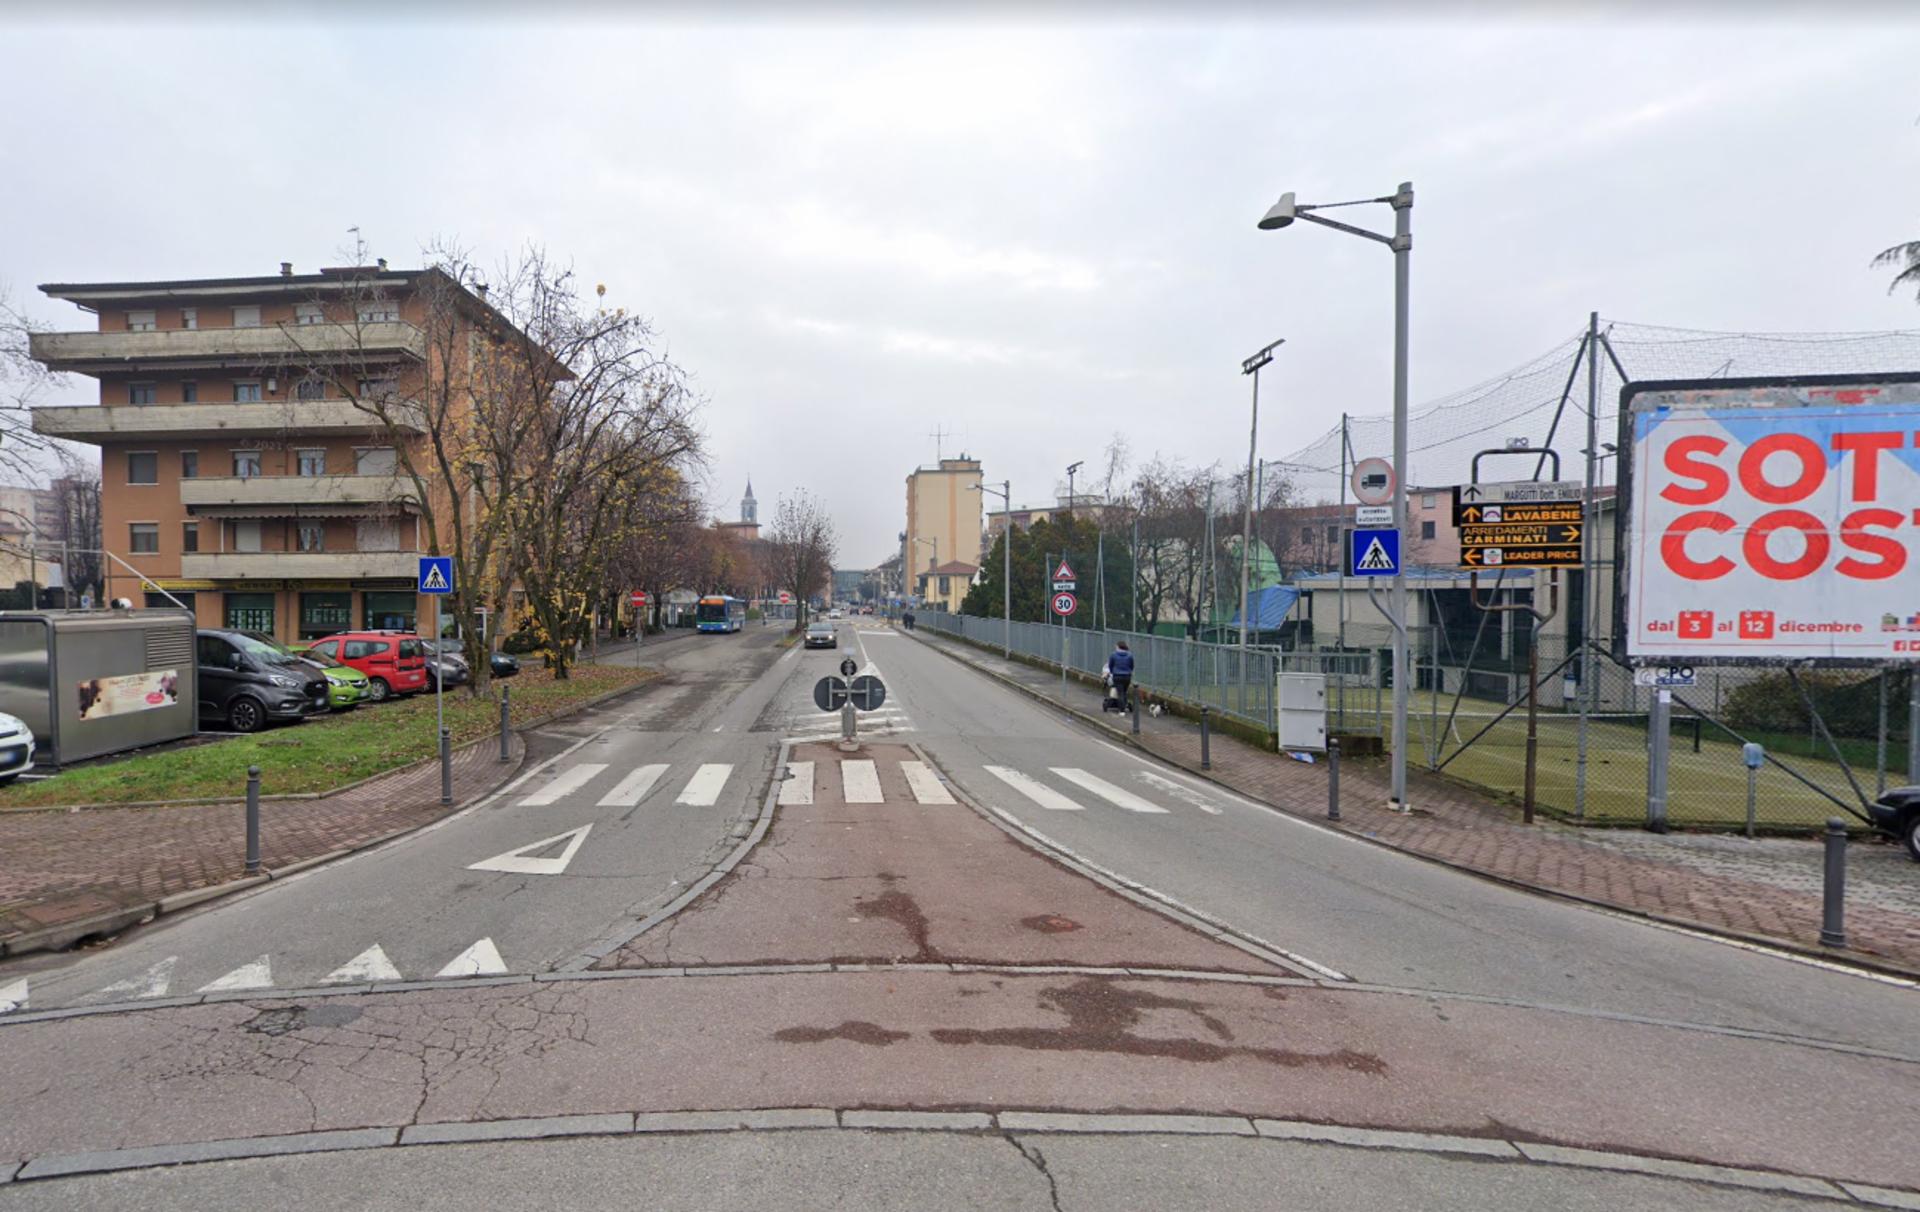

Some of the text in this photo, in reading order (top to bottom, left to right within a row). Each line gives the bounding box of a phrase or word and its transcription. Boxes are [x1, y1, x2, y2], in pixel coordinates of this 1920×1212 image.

[1659, 431, 1920, 505] SOT
[1503, 510, 1580, 521] LAVABENE
[1464, 526, 1548, 535] ARREDAMENTI
[1464, 535, 1548, 544] CARMINATI
[1660, 508, 1920, 580] COS
[1504, 551, 1579, 560] LEADER PRICE
[1057, 599, 1071, 610] 30
[1647, 620, 1863, 633] dal 3 al 12 dicembre
